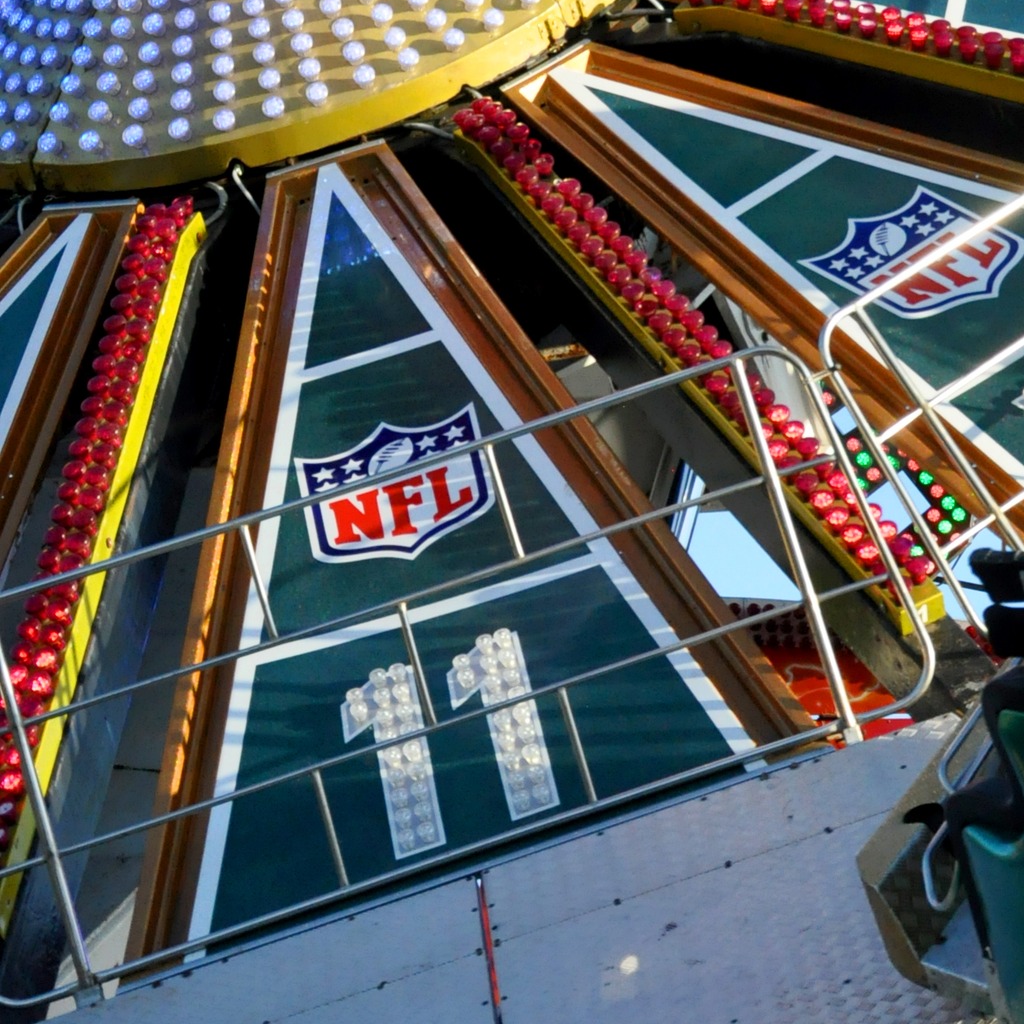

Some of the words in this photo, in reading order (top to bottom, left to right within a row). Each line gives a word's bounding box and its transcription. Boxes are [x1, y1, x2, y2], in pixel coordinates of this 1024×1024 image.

[870, 231, 1004, 305] NFL
[329, 466, 474, 545] NFL
[340, 628, 561, 860] 11
